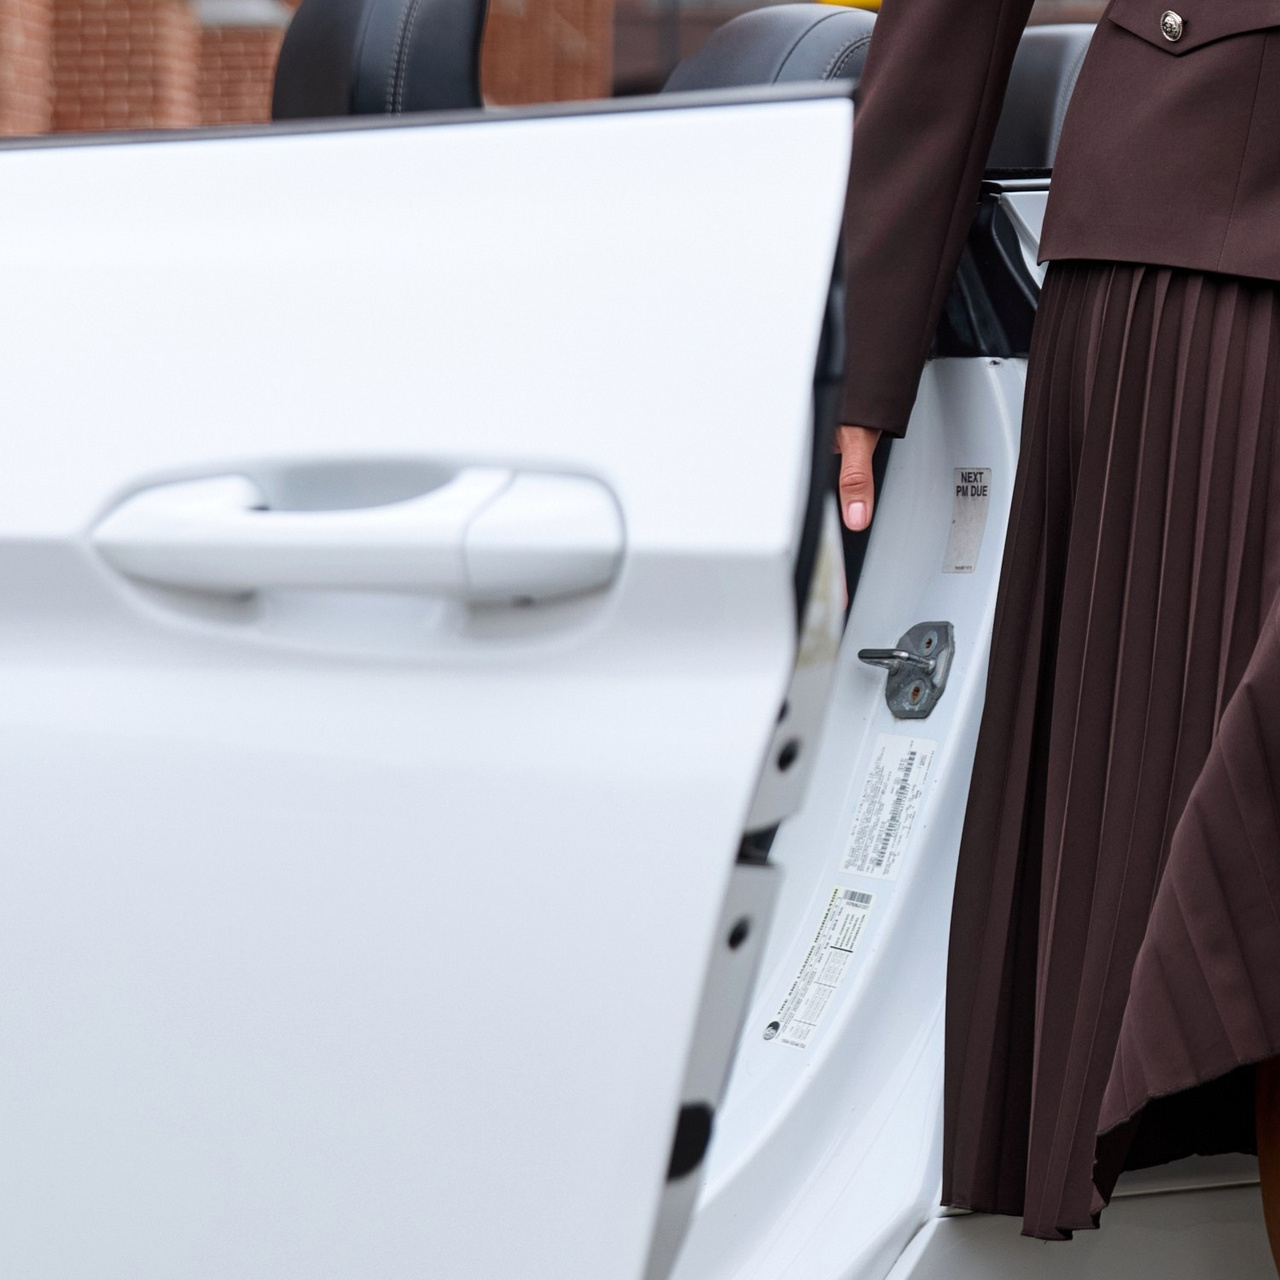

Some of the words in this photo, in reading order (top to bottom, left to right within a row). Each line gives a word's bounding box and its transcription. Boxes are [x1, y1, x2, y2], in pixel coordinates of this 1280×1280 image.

[961, 471, 984, 483] NEXT
[956, 485, 969, 497] PM
[970, 485, 988, 497] DUE
[814, 888, 839, 943] INFORMATION
